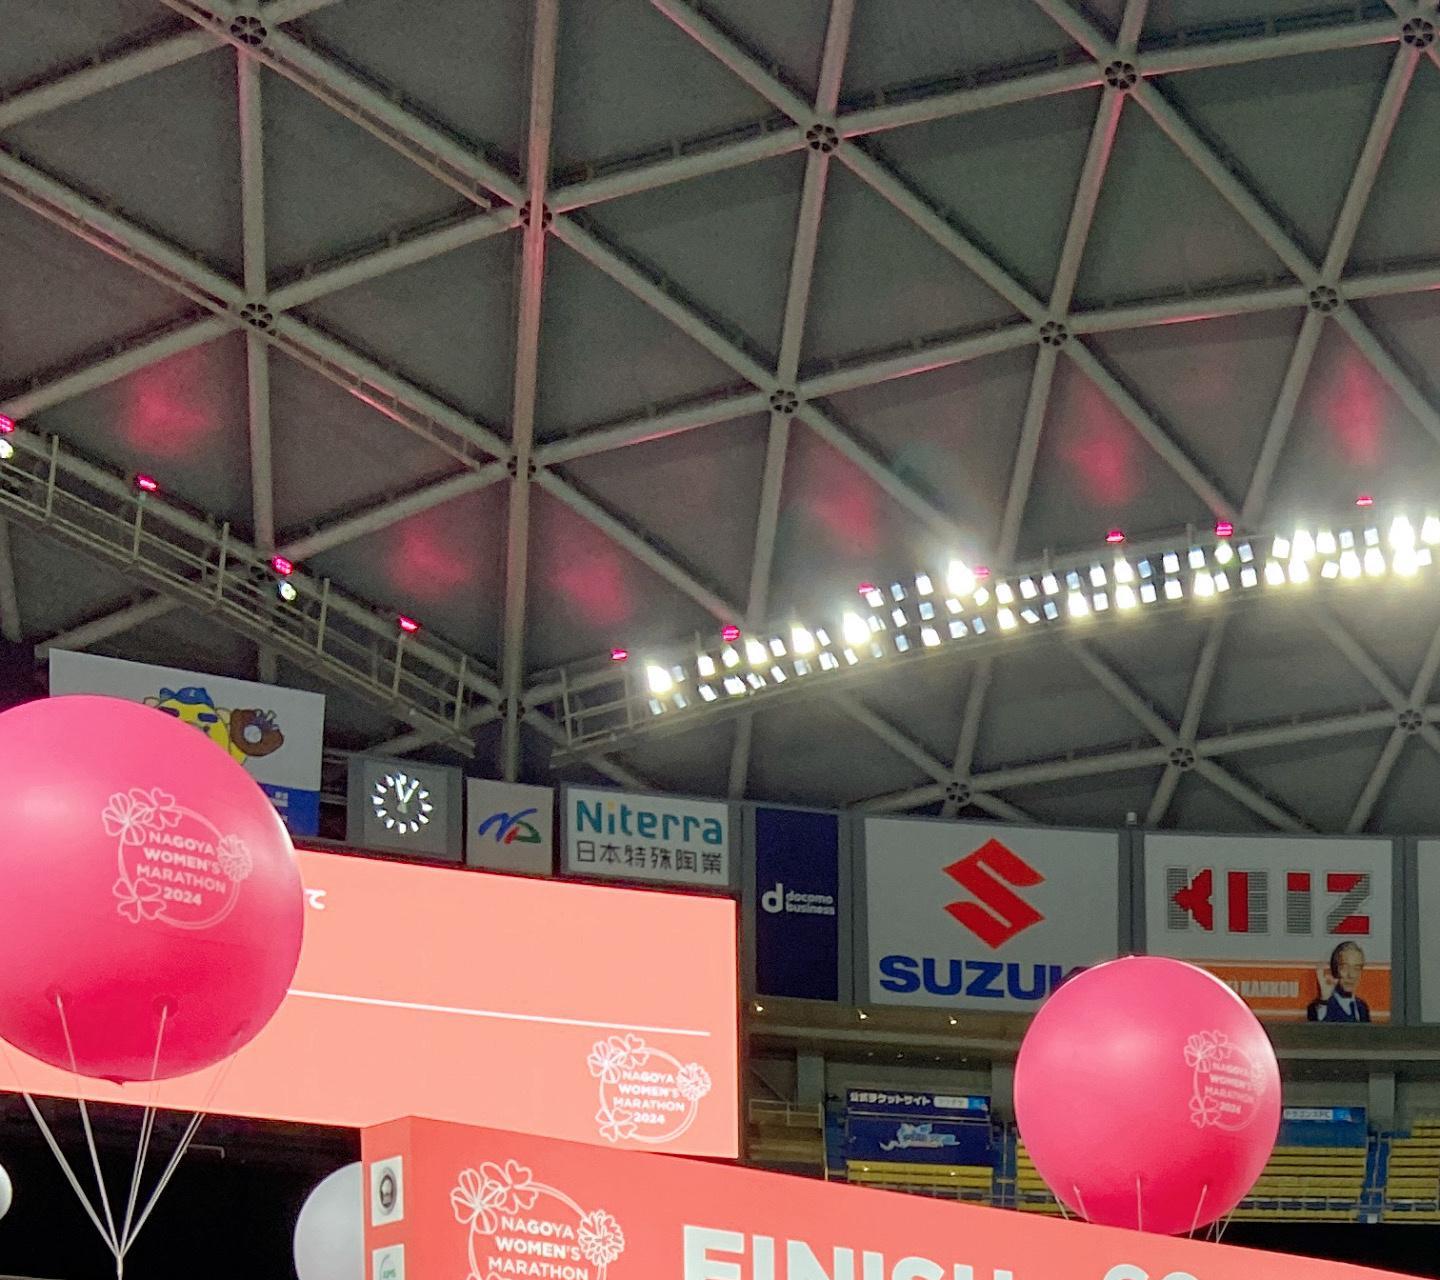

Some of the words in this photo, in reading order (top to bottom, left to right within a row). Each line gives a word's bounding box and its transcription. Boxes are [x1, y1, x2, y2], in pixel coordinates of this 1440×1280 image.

[576, 799, 723, 845] Niterra
[149, 831, 218, 855] NAGOYA
[143, 847, 222, 875] WOMEN'S
[577, 841, 722, 875] 日本特殊陶業
[136, 864, 226, 894] MARATHON
[163, 886, 202, 906] 2024
[786, 890, 834, 905] docomo
[786, 902, 836, 916] business
[621, 1070, 675, 1084] NAGOYA
[618, 1083, 681, 1099] WOMEN'S
[612, 1097, 685, 1113] MARATHON
[632, 1111, 666, 1125] 2024
[501, 1215, 575, 1241] NAGOYA
[494, 1235, 582, 1262] WOMEN'S
